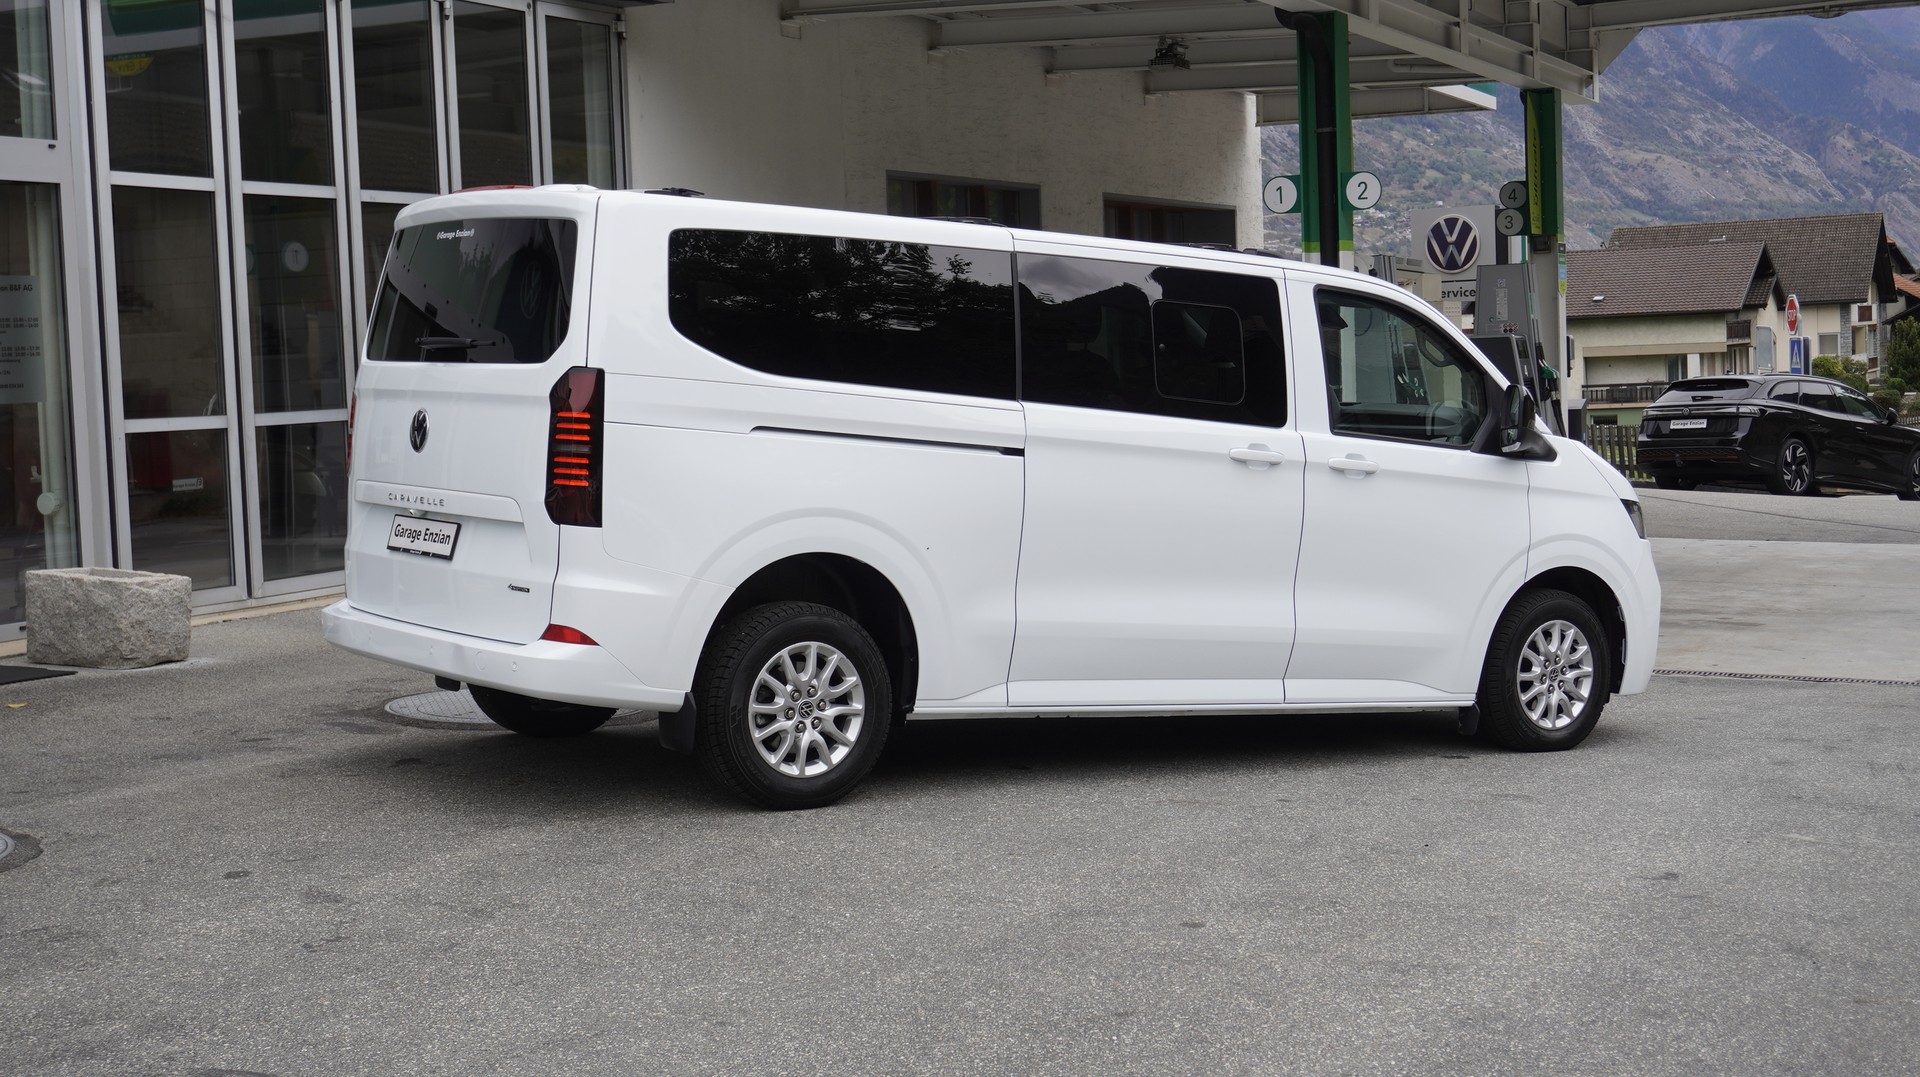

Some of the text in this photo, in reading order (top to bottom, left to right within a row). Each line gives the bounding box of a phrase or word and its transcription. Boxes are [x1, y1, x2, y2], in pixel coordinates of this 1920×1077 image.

[1275, 186, 1284, 205] 1
[1357, 181, 1369, 200] 2
[1508, 188, 1518, 203] 4
[1504, 215, 1514, 230] 3
[1441, 286, 1477, 299] ervice
[1787, 309, 1797, 322] STOP
[388, 492, 445, 507] CARAVELLE
[394, 523, 451, 546] Garage Enzian
